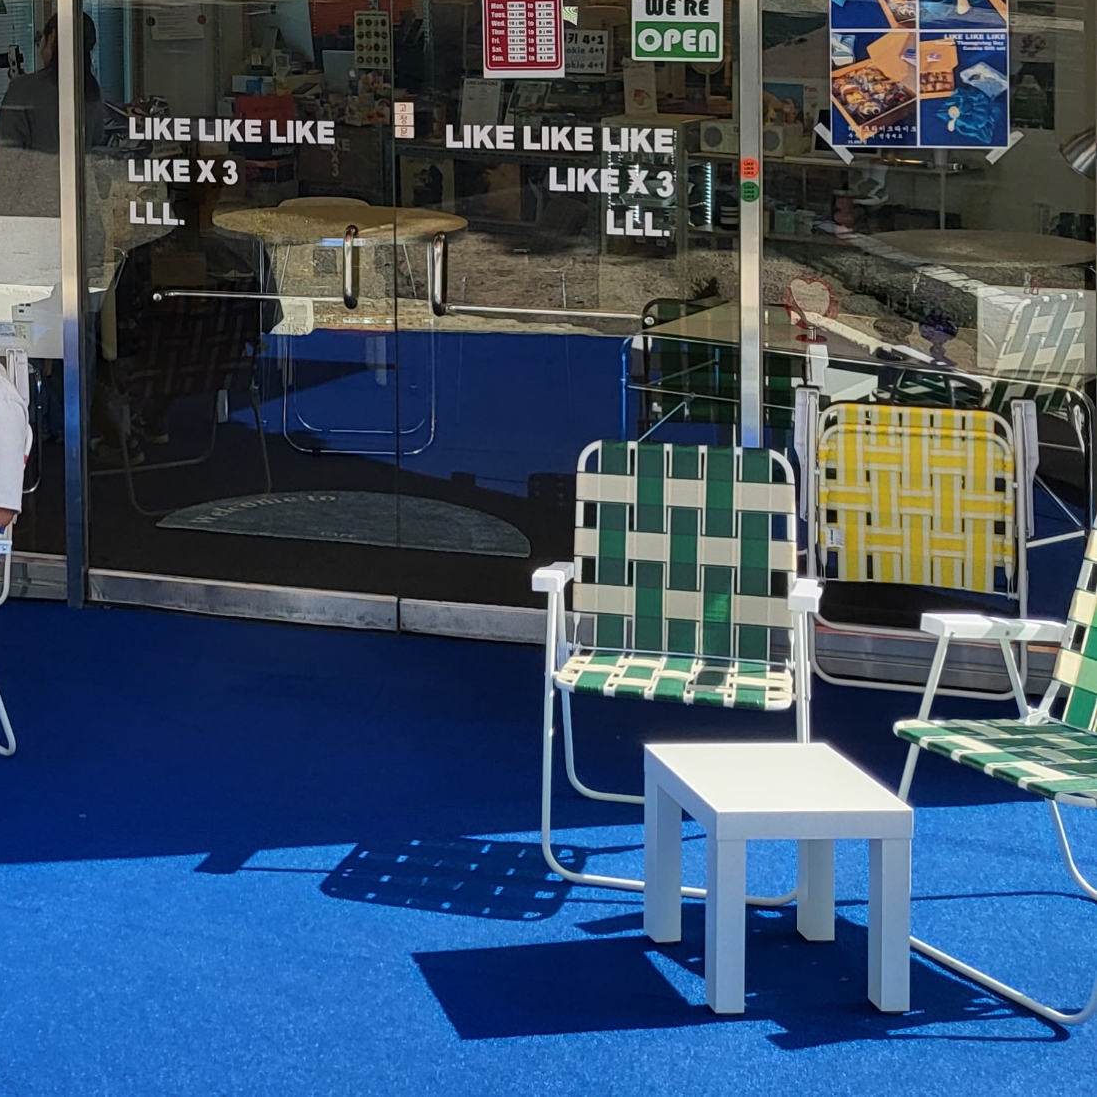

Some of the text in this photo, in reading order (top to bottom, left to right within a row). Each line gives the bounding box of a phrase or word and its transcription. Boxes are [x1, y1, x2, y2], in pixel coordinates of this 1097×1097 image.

[582, 35, 604, 44] 4+1
[637, 28, 717, 53] OPEN
[128, 117, 335, 145] LIKE LIKE LIKE
[445, 124, 674, 153] LIKE LIKE LIKE
[128, 159, 238, 185] LIKE X 3
[549, 166, 674, 197] LIKE X 3
[130, 201, 185, 226] LLL.
[606, 210, 670, 237] LLL.
[190, 496, 298, 523] Welcome
